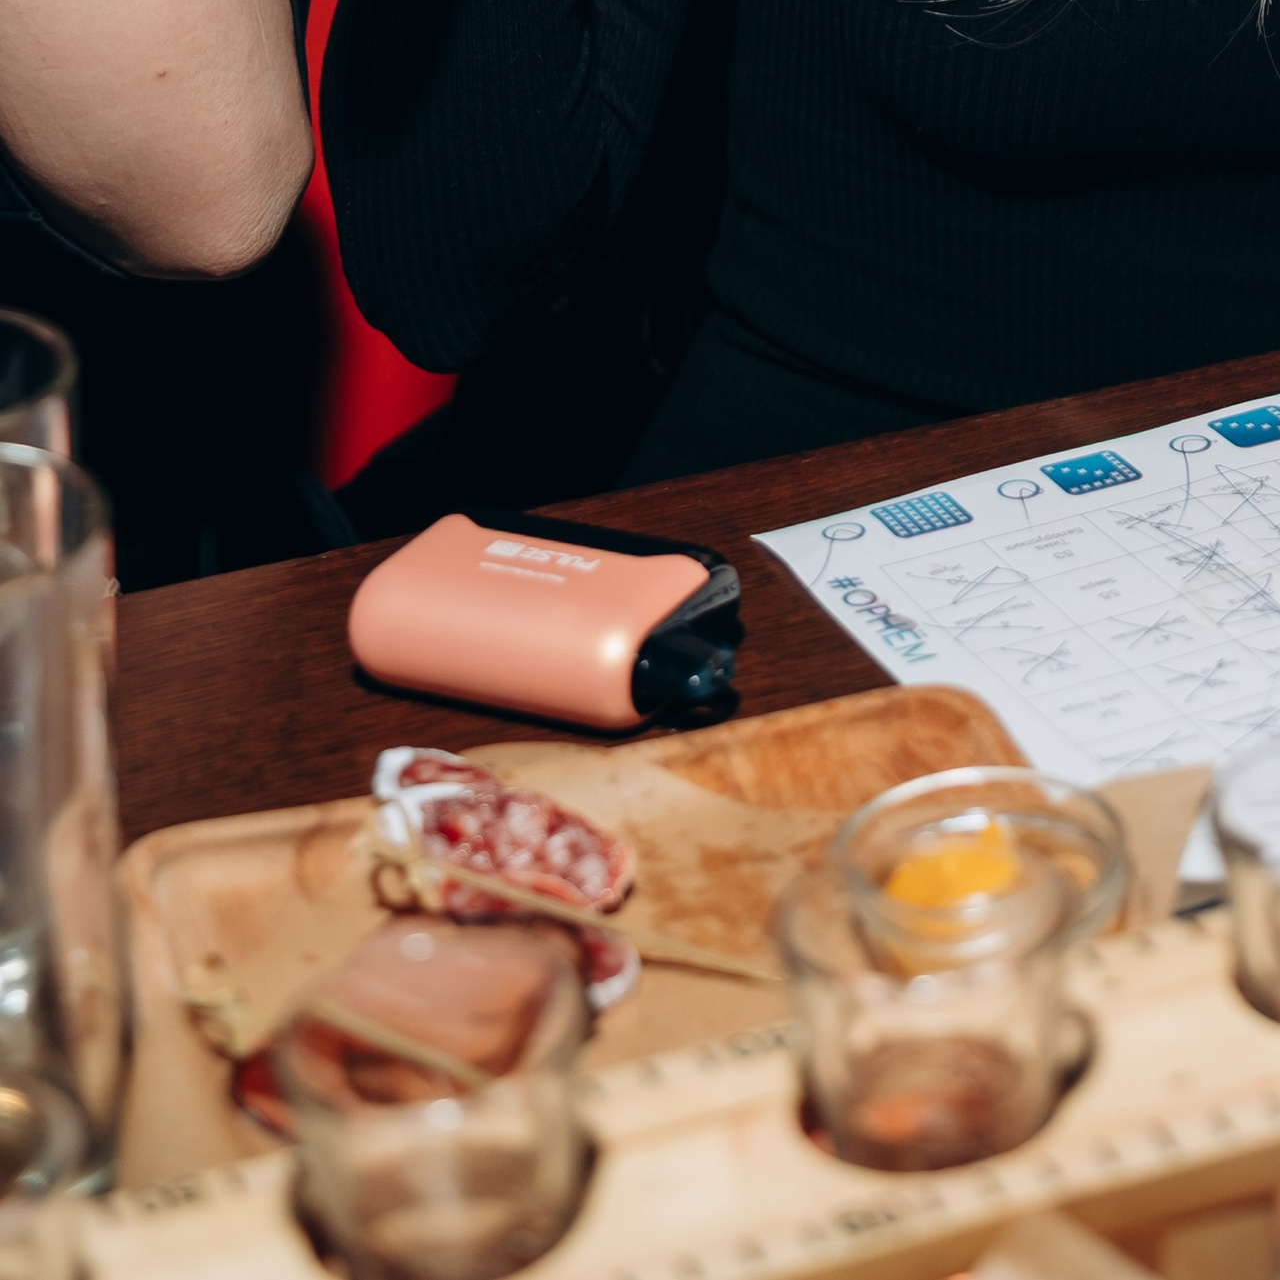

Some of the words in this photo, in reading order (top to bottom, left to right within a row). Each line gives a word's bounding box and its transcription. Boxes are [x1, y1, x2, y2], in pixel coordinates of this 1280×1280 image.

[1004, 526, 1082, 550] Белорусских
[1035, 539, 1067, 550] Тима
[520, 547, 601, 572] PULSE
